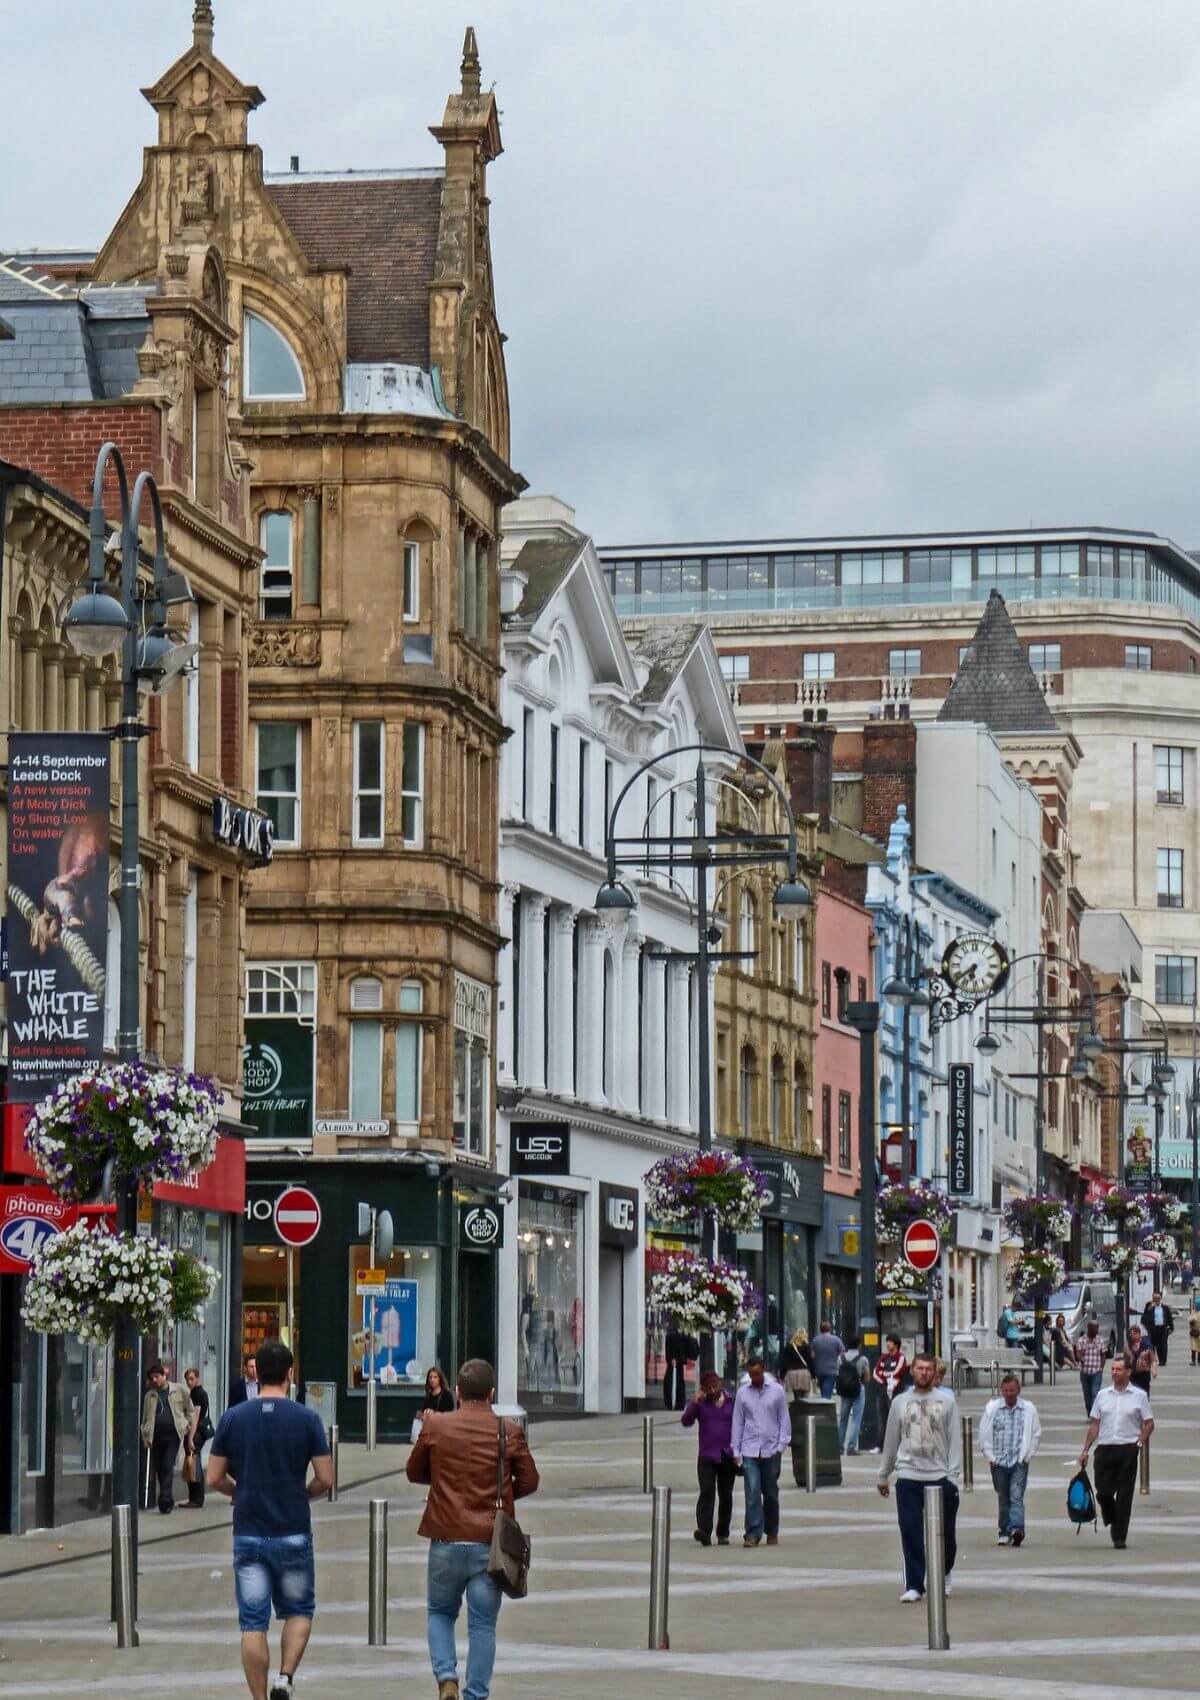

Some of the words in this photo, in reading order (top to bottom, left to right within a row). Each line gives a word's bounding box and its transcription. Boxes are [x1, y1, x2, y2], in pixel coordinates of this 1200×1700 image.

[42, 755, 107, 769] September
[12, 770, 49, 781] Leeds
[51, 770, 82, 781] Dock
[12, 785, 22, 795] A
[24, 786, 47, 795] new
[50, 785, 91, 795] version
[12, 799, 26, 809] of
[27, 799, 58, 812] Moby
[61, 799, 86, 809] Dick
[12, 814, 26, 826] by
[28, 814, 60, 826] Slung
[63, 814, 88, 824] Low
[12, 829, 29, 838] On
[10, 969, 56, 994] THE
[27, 991, 99, 1016] WHITE
[13, 1015, 89, 1041] WHALE
[12, 1059, 100, 1070] thewhitewhale.org
[247, 1060, 265, 1068] THE
[956, 1069, 965, 1128] QUEENS
[244, 1101, 274, 1111] WITH
[321, 1123, 353, 1131] ALBION
[356, 1122, 382, 1131] PLACE
[516, 1136, 563, 1153] USC
[956, 1130, 965, 1189] ARCADE
[8, 1198, 62, 1216] phones
[471, 1223, 492, 1231] BODY
